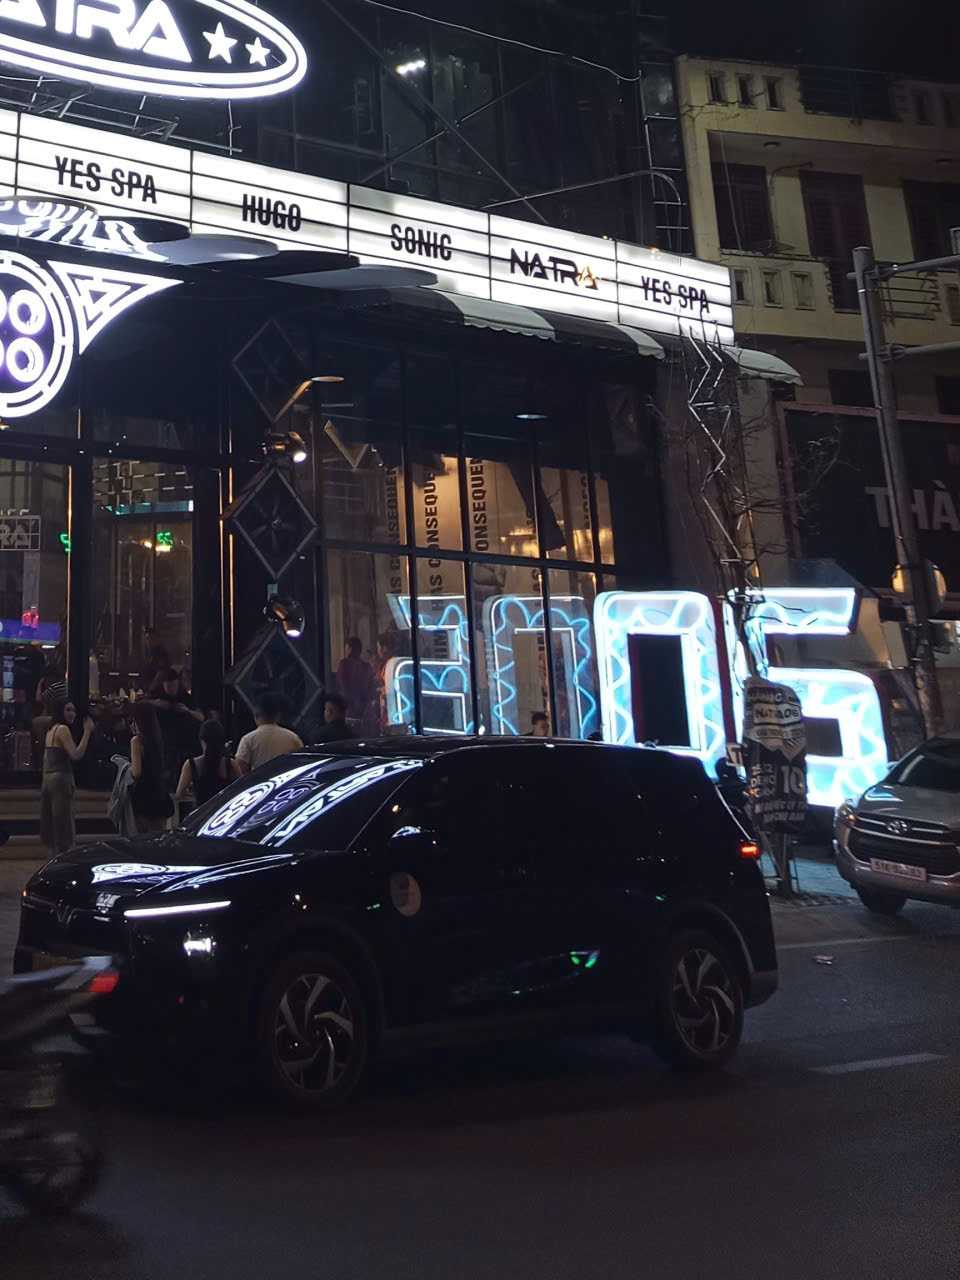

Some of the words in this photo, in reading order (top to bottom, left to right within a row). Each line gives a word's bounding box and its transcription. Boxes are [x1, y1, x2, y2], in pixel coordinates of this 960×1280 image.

[54, 155, 102, 193] YES
[111, 172, 158, 205] SPA
[242, 193, 301, 232] HUGO
[390, 223, 452, 261] SONIC
[641, 275, 672, 306] YES
[678, 283, 711, 314] SPA
[470, 458, 490, 551] ONSEQUEN
